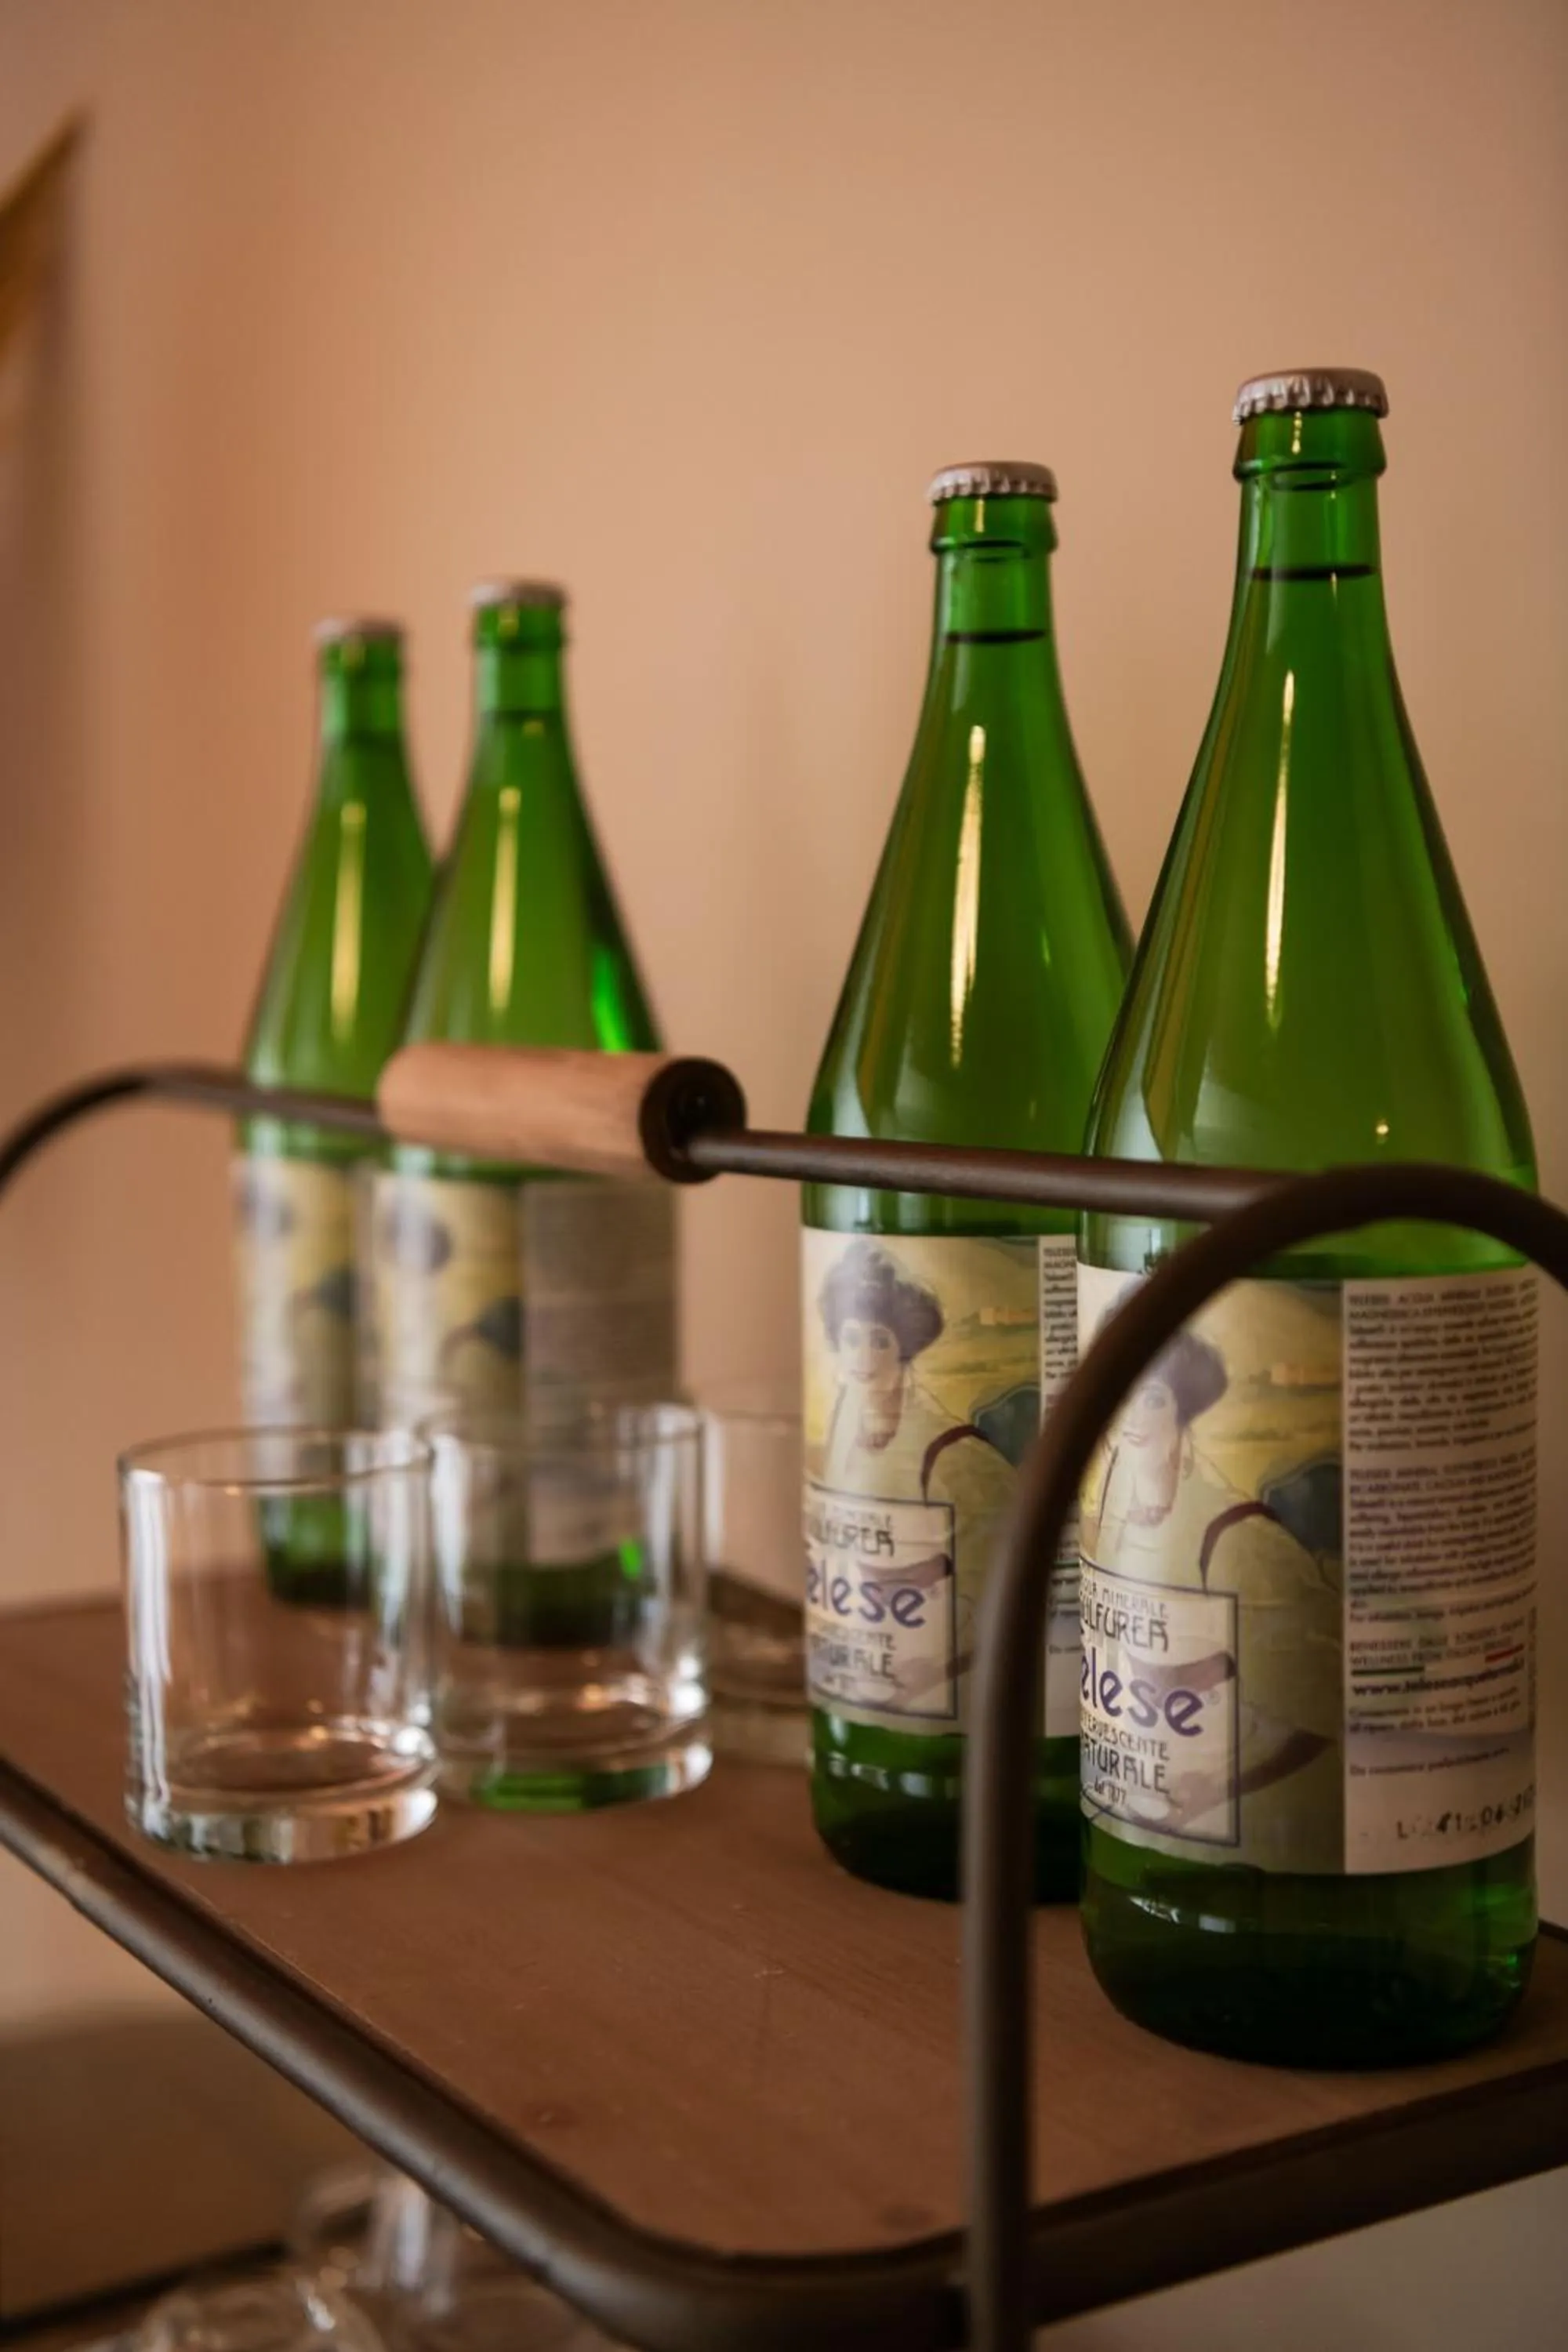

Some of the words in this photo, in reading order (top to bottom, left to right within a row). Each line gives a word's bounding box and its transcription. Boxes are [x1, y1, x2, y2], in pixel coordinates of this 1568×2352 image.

[807, 1559, 926, 1629] elese
[1081, 1598, 1169, 1653] ULFUREA
[1081, 1646, 1204, 1737] elese
[1081, 1732, 1171, 1795] ATURALE
